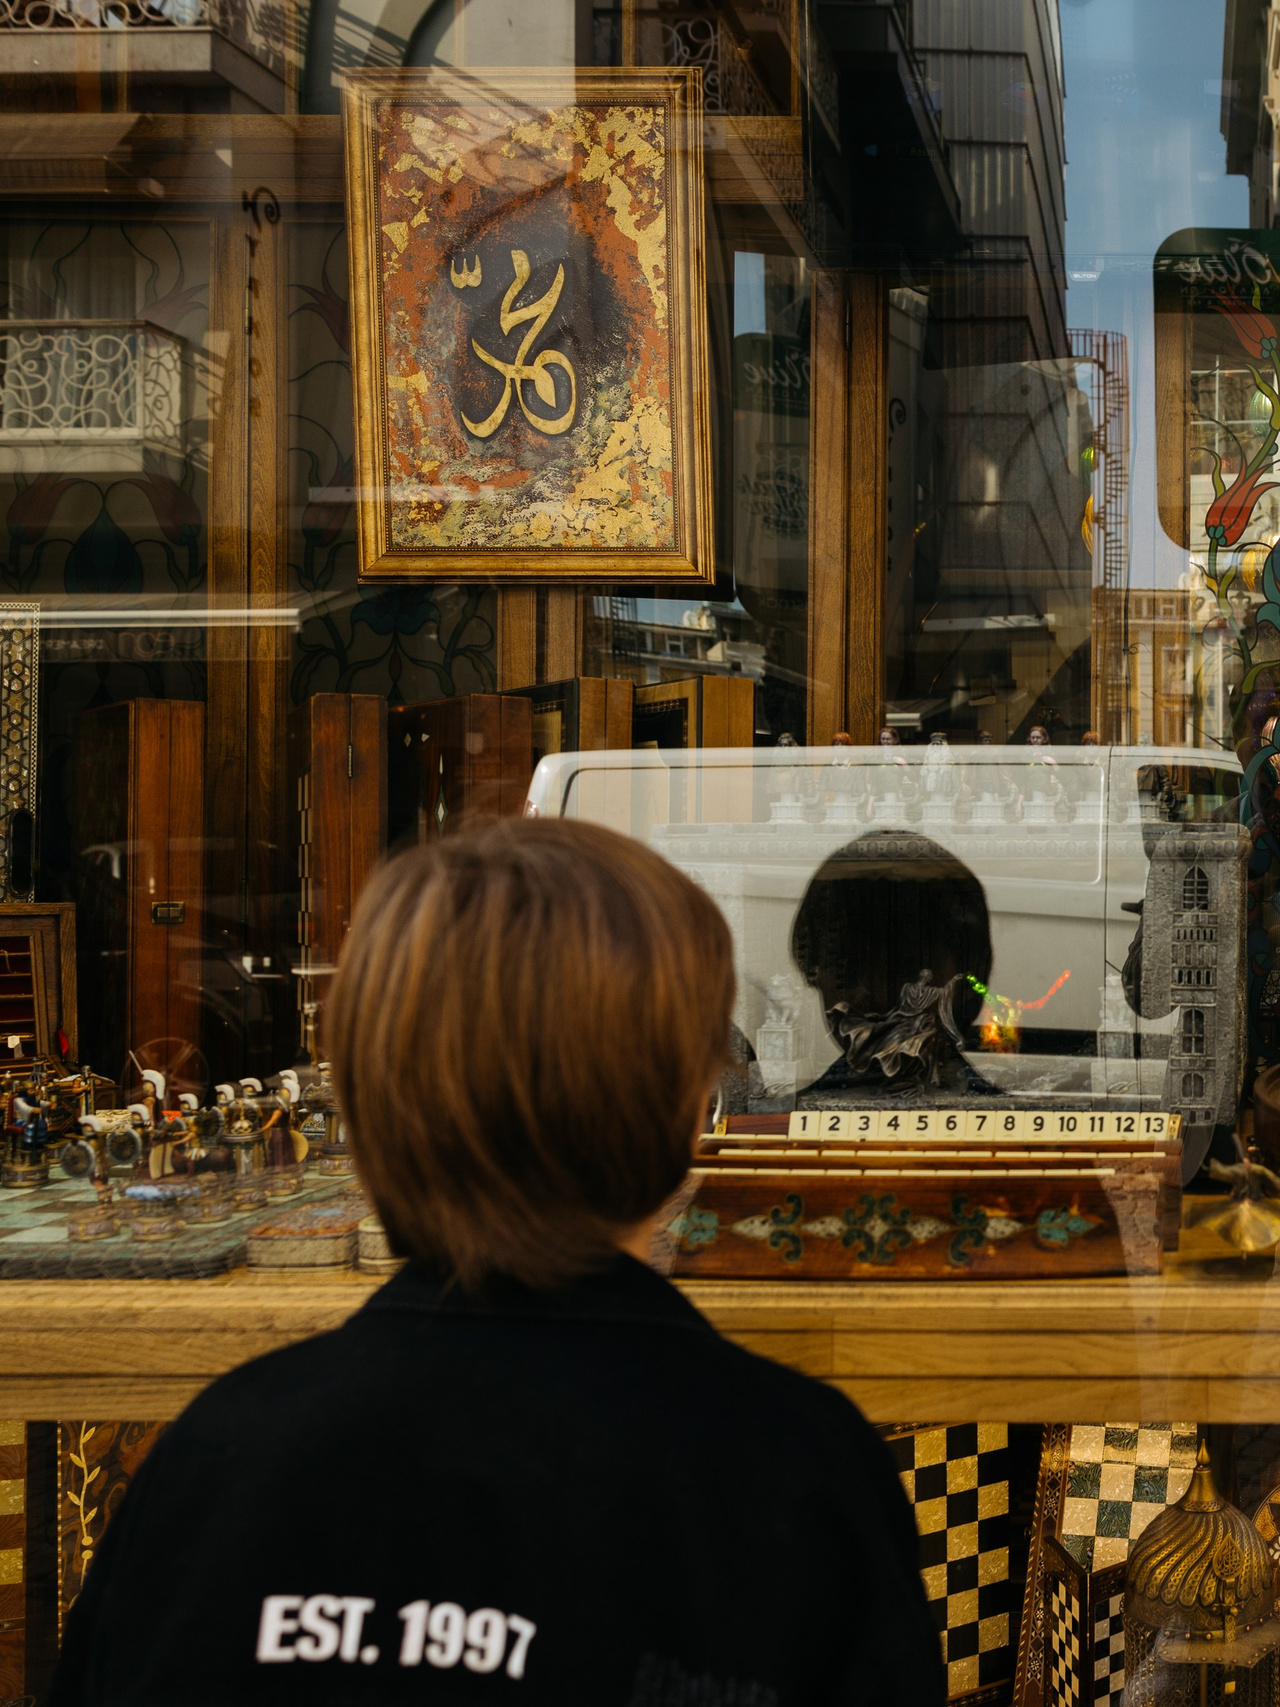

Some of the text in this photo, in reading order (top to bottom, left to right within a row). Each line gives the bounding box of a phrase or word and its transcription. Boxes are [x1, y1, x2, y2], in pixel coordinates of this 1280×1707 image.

[800, 1115, 808, 1132] 1
[827, 1115, 841, 1132] 2
[858, 1115, 871, 1132] 3
[886, 1114, 901, 1132] 4
[915, 1114, 929, 1132] 5
[945, 1114, 958, 1132] 6
[975, 1114, 988, 1132] 7
[1003, 1114, 1016, 1132] 8
[1032, 1115, 1045, 1132] 9
[1058, 1115, 1078, 1133] 10
[1089, 1115, 1105, 1133] 11
[1115, 1116, 1136, 1133] 12
[1144, 1116, 1165, 1134] 13
[255, 1594, 537, 1680] EST. 1997
